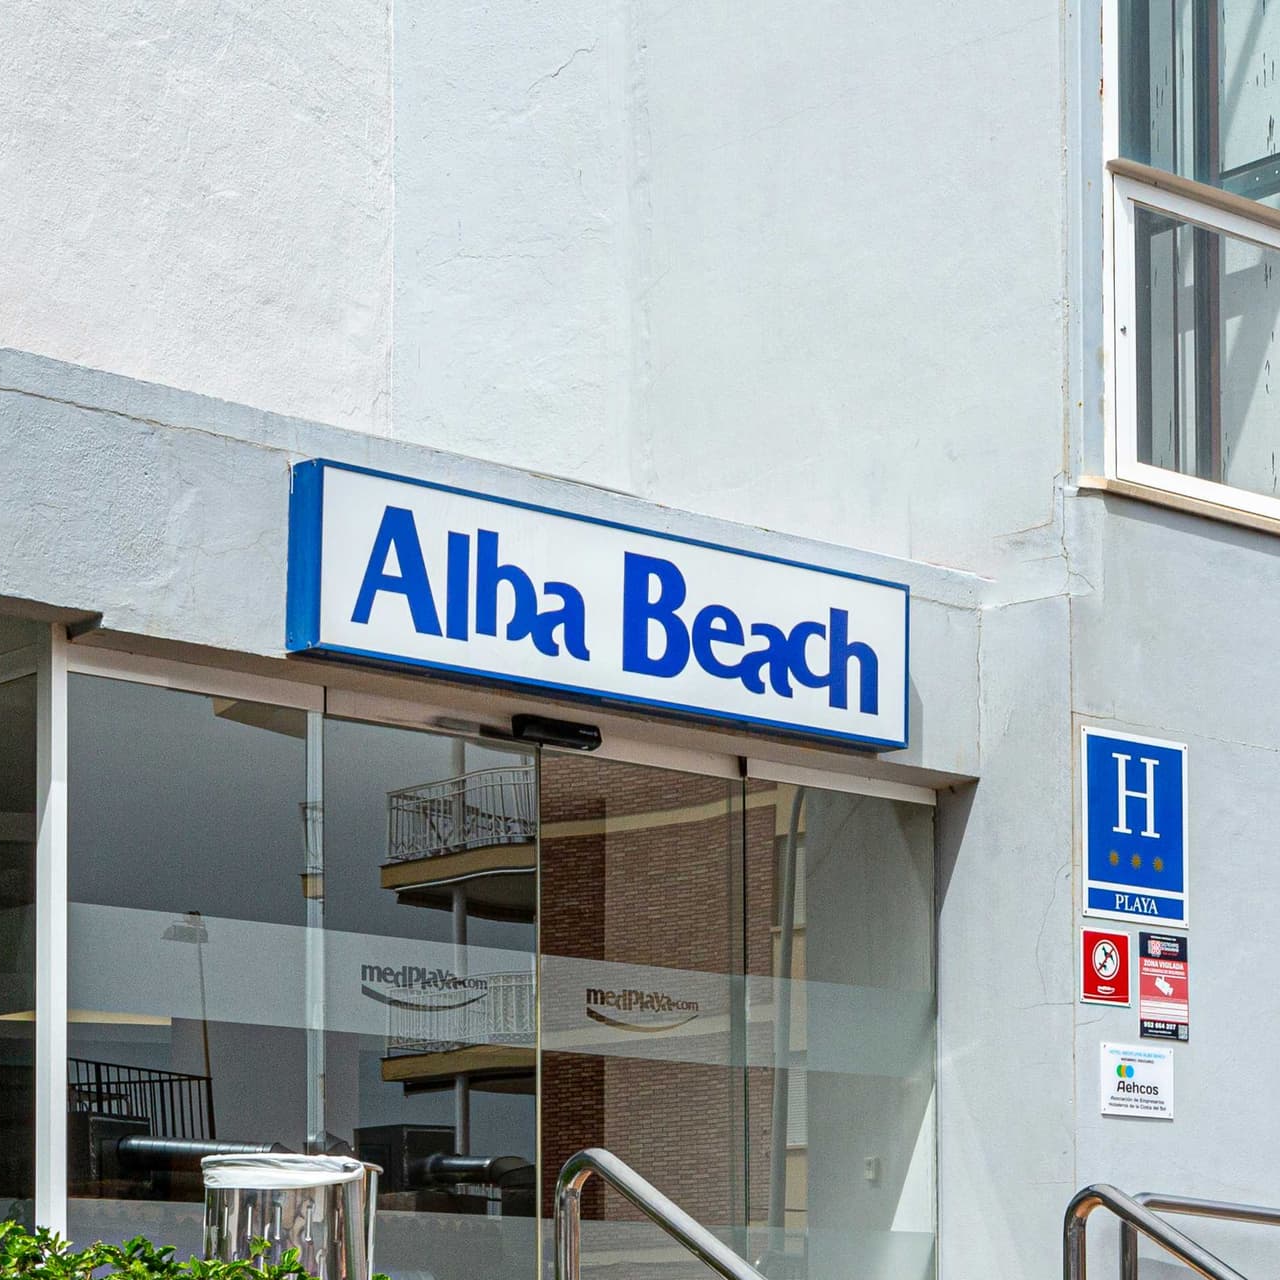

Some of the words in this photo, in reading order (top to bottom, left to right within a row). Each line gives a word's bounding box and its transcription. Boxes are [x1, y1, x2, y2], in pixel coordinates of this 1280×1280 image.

[350, 505, 591, 662] Alba
[623, 551, 880, 715] Beach
[1111, 752, 1160, 839] H
[1114, 893, 1159, 915] PLAYA
[1117, 1080, 1159, 1095] Aehcos
